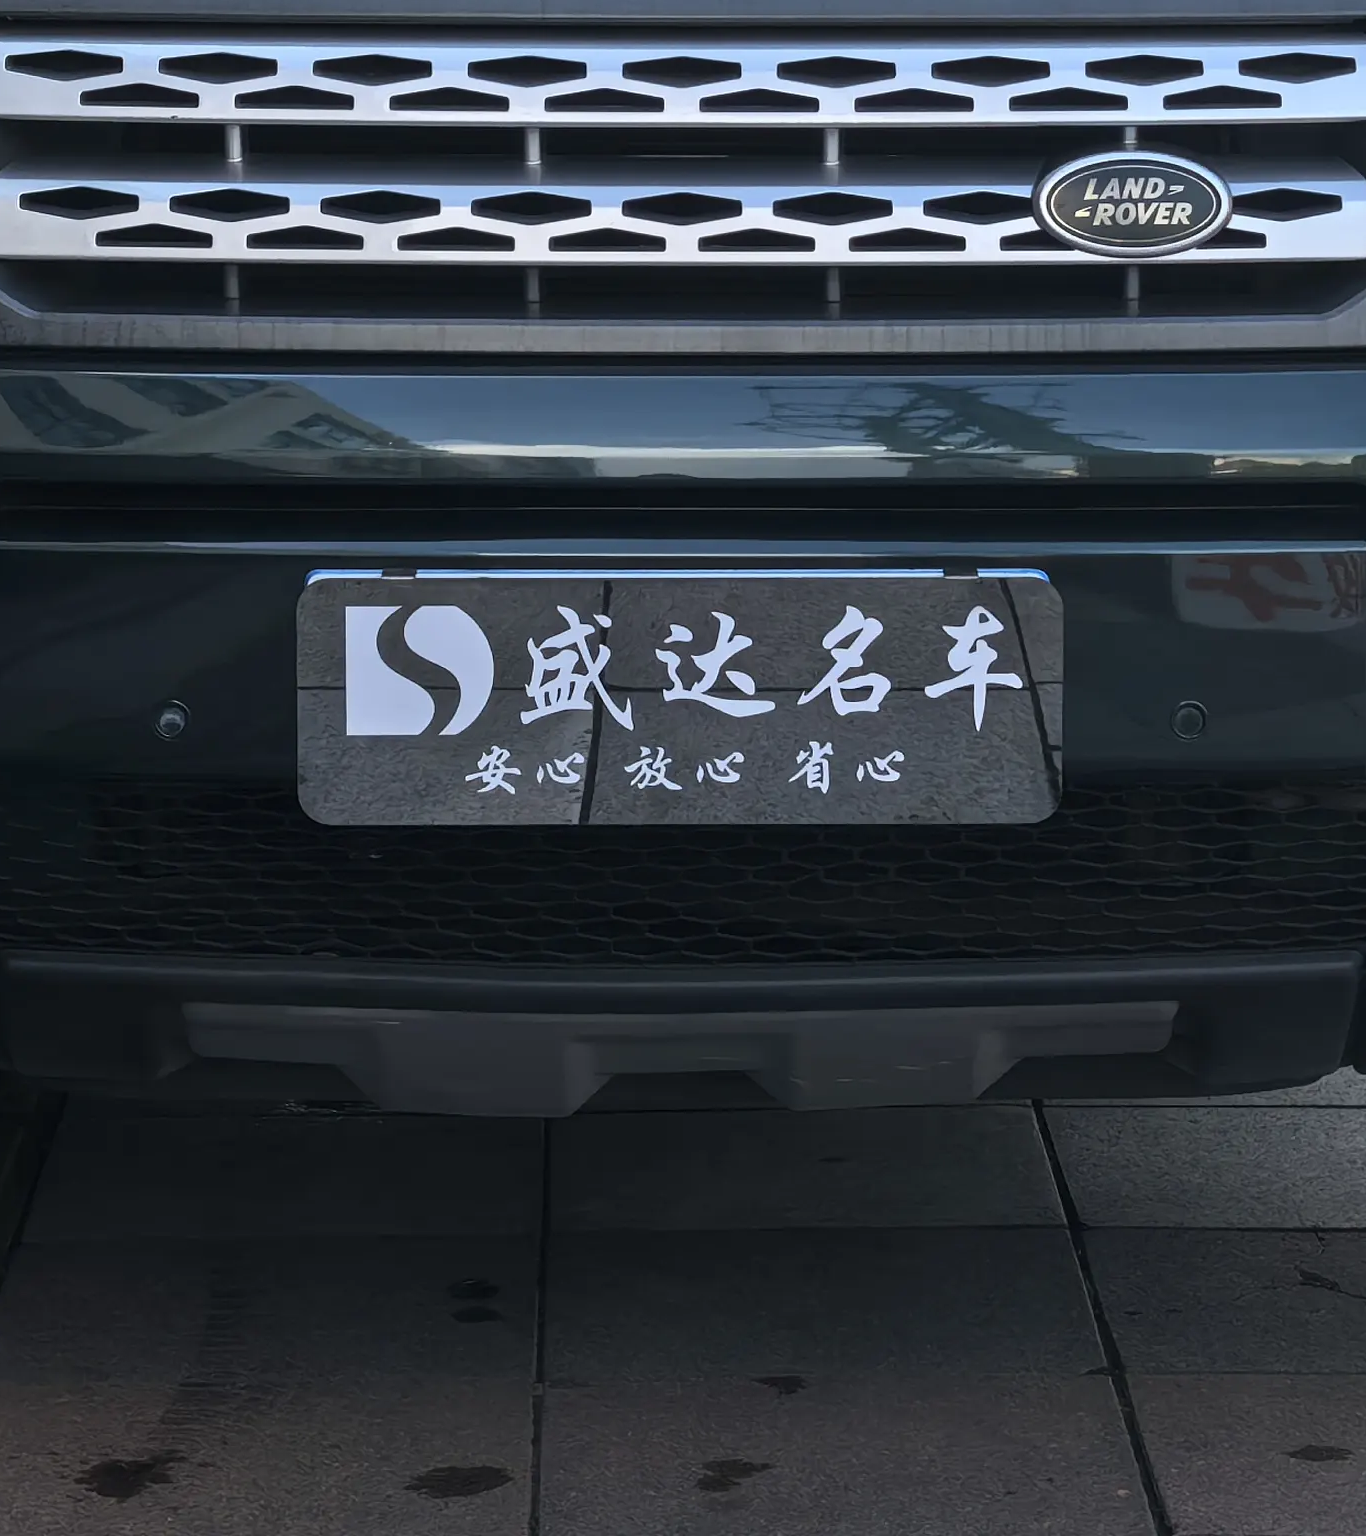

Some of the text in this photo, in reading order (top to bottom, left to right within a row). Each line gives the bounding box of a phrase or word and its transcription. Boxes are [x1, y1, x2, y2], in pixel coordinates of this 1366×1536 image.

[1083, 177, 1166, 201] LAND
[1092, 202, 1193, 226] ROVER
[521, 605, 1024, 732] 盛达名车
[464, 740, 906, 795] 安心 放心 省心
